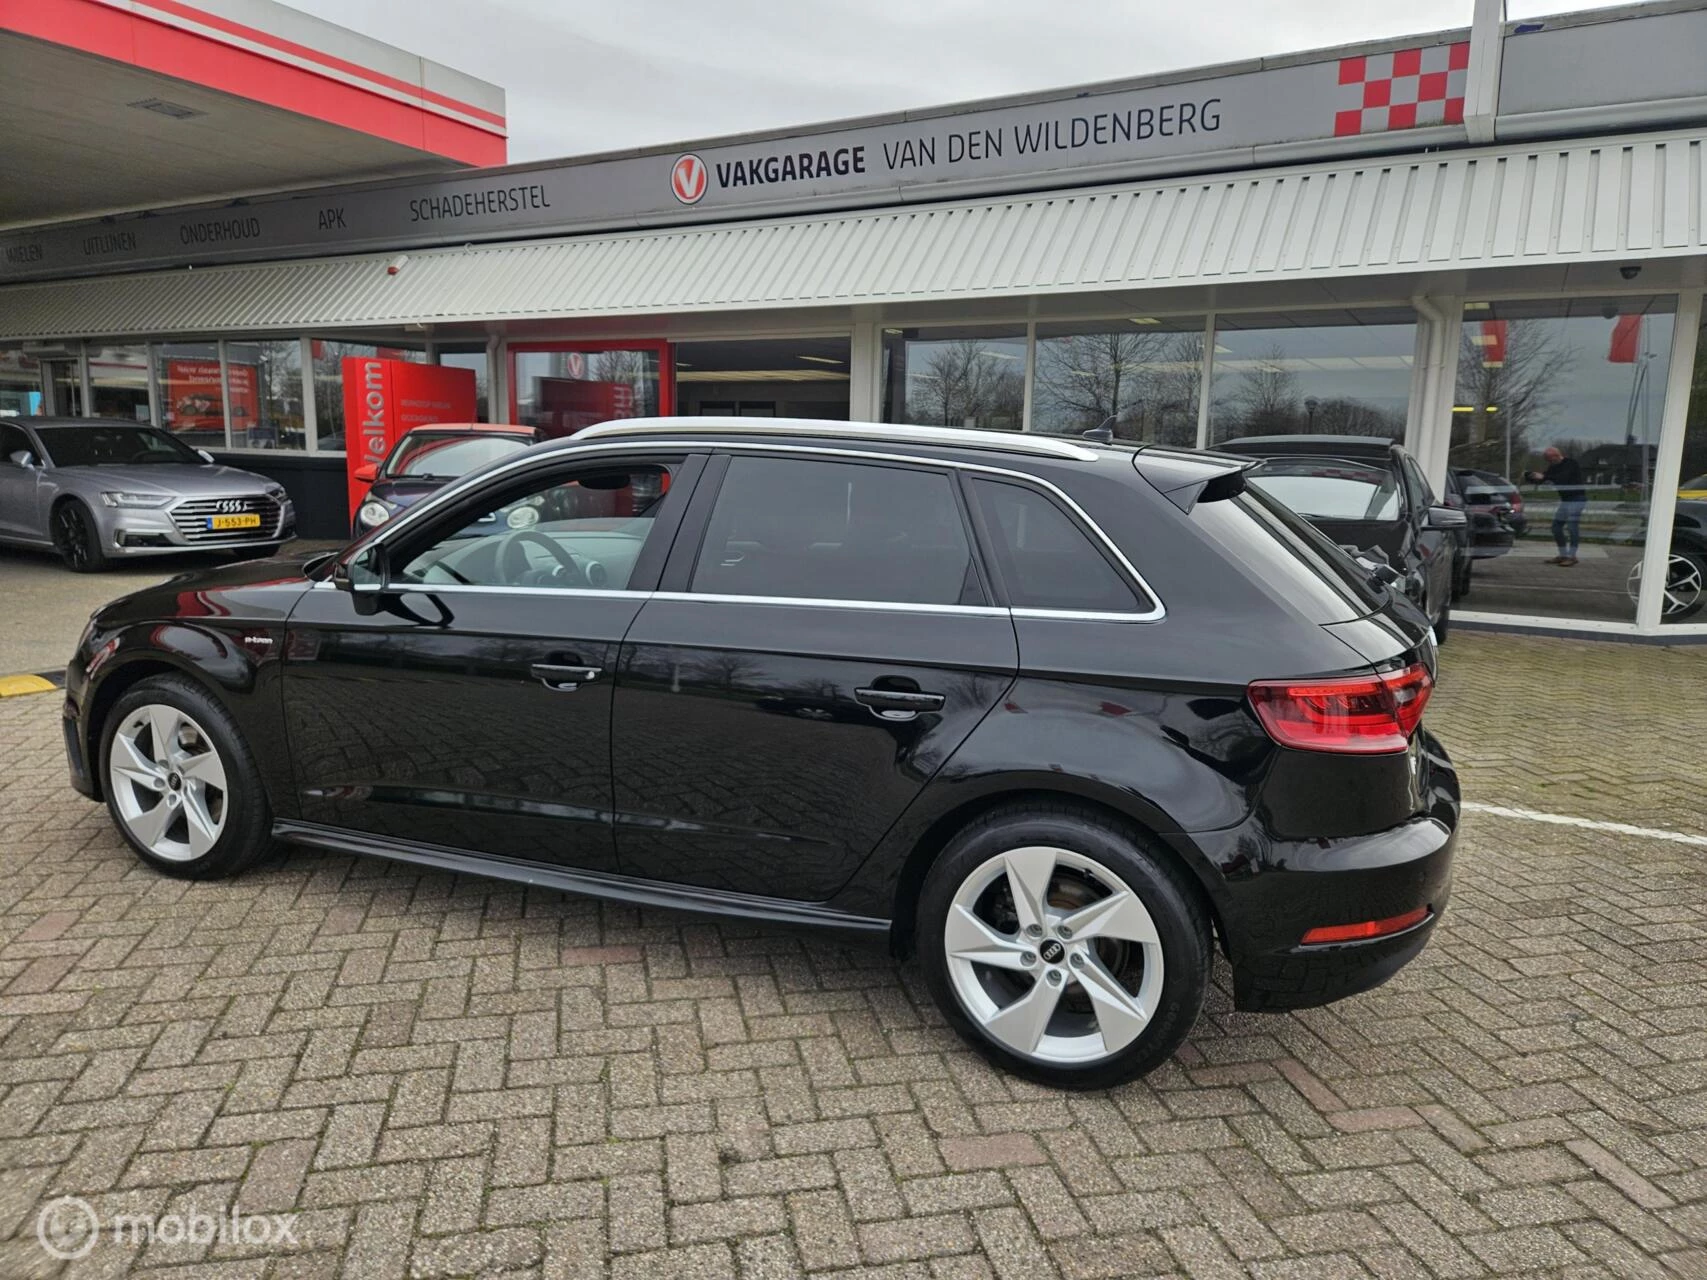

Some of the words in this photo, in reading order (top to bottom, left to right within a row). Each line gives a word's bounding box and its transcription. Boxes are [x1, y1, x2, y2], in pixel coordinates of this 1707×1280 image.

[716, 146, 866, 188] VAKGARAGE
[882, 136, 937, 170] VAN
[947, 128, 1003, 163] DEN
[1013, 98, 1222, 154] WILDENBERG
[318, 208, 346, 231] APK
[409, 185, 551, 222] SCHADEHERSTEL
[180, 217, 261, 246] ONDERHOUD
